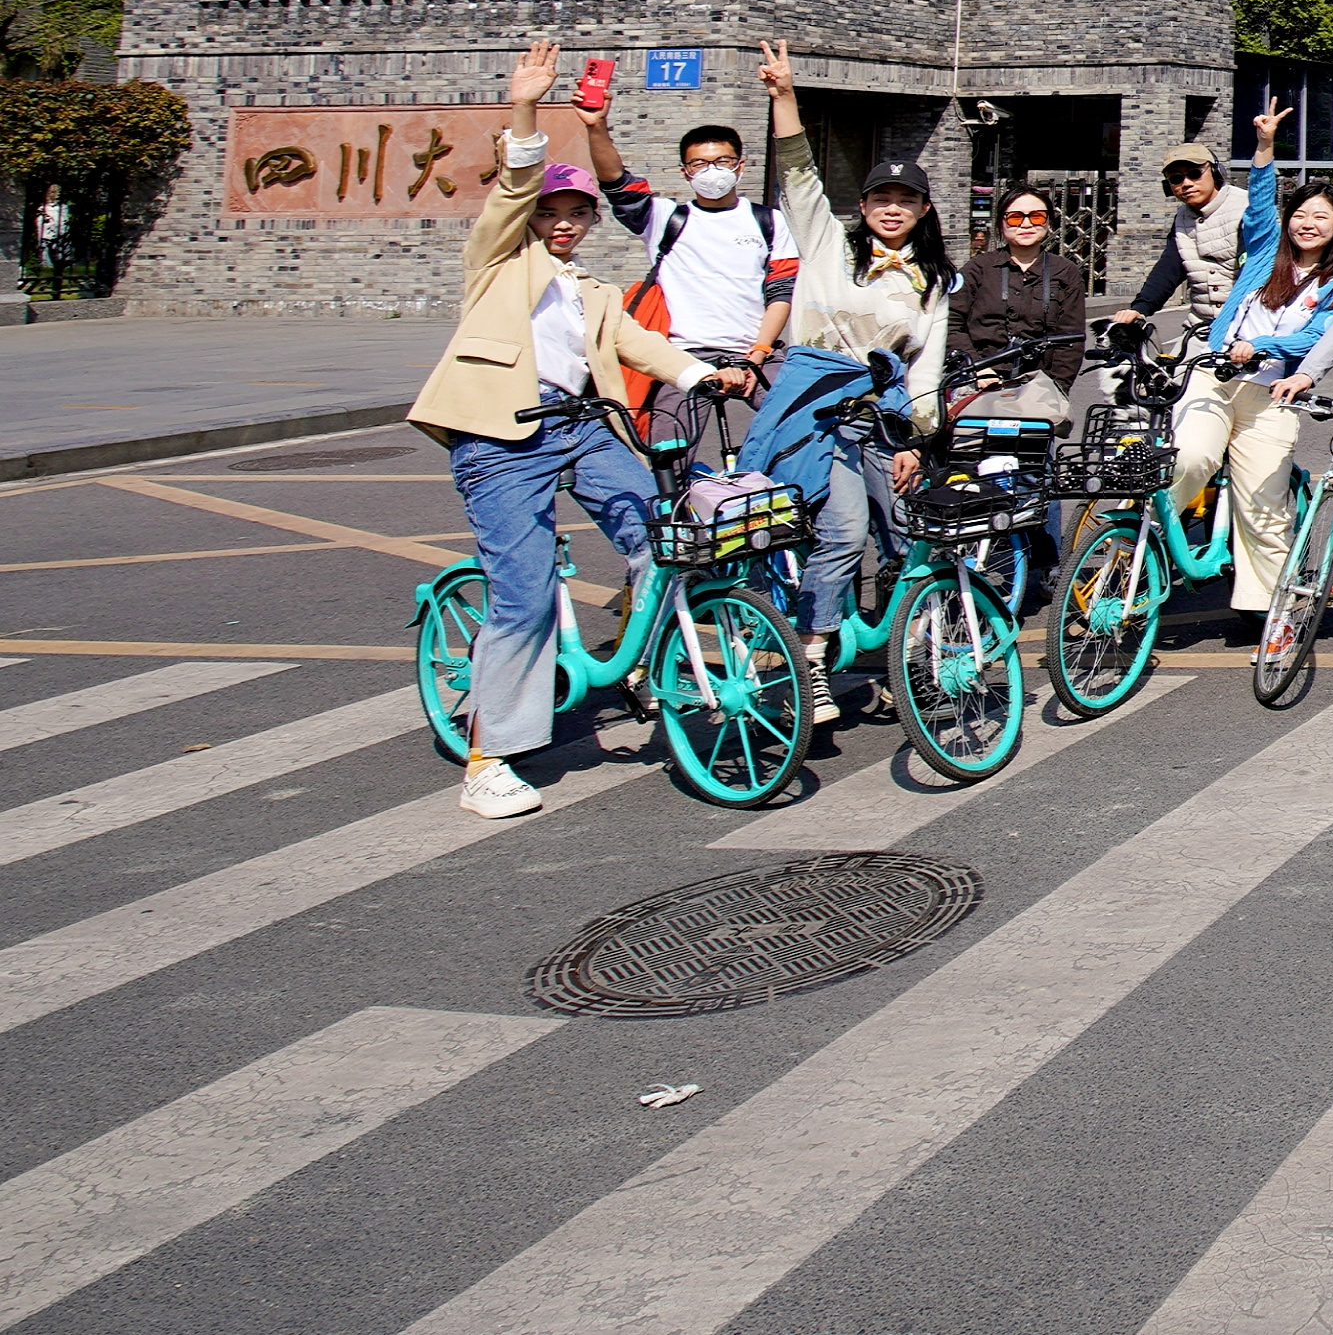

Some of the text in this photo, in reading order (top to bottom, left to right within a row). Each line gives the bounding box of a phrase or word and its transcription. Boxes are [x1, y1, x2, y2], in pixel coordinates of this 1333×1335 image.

[660, 61, 687, 81] 17
[244, 122, 504, 206] 四川大
